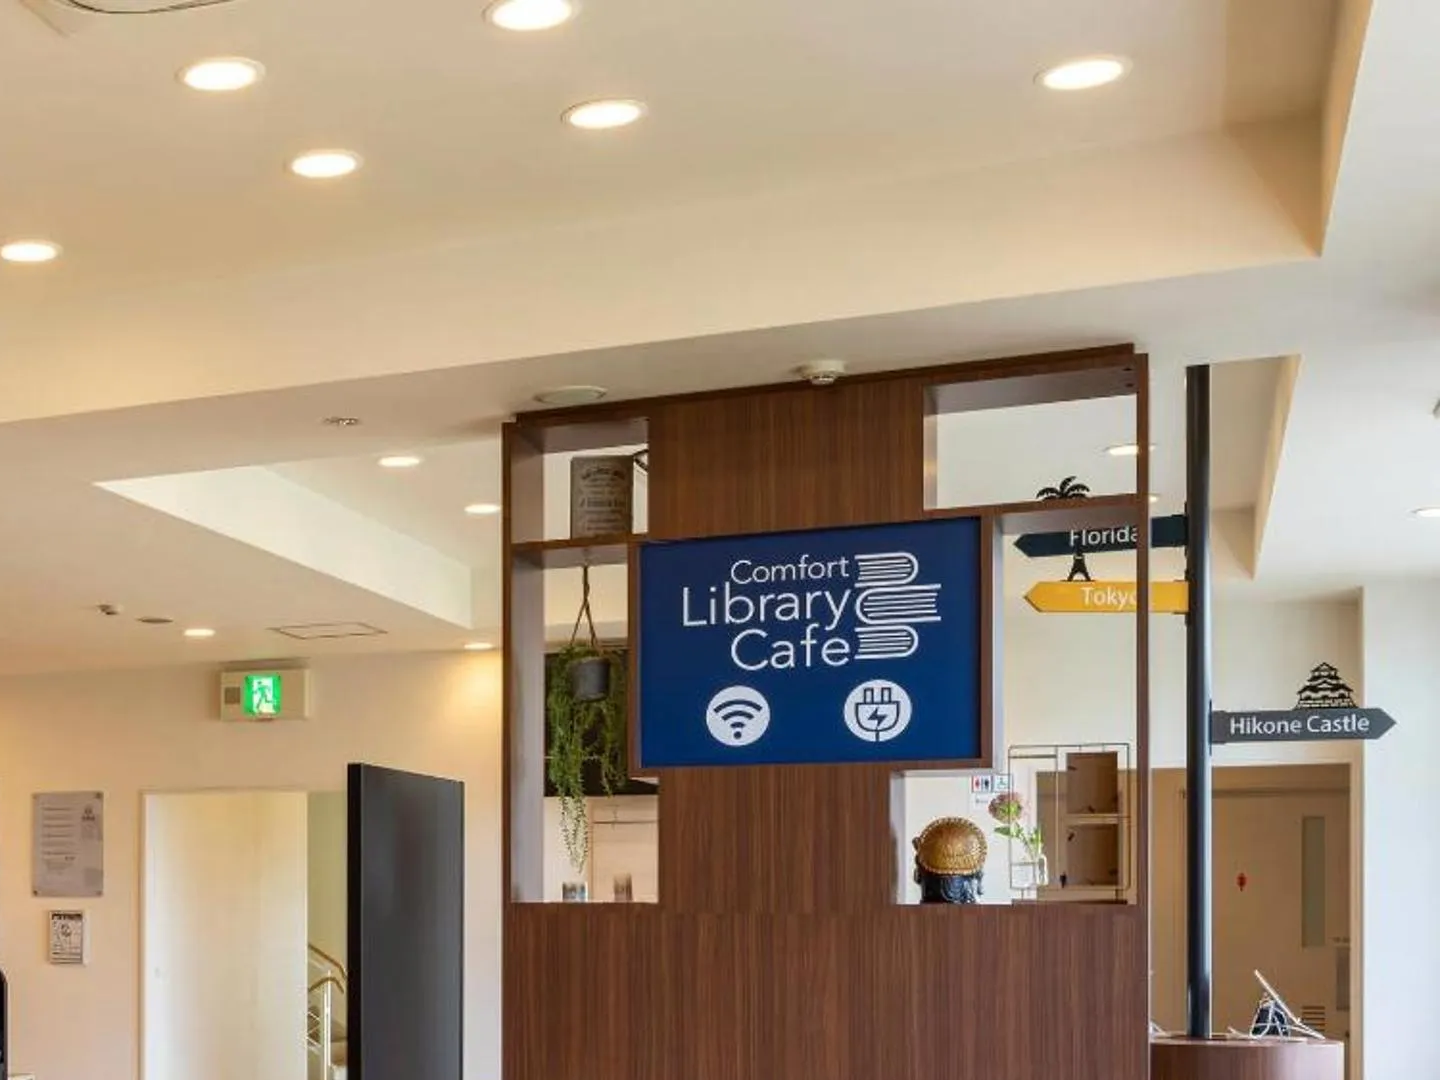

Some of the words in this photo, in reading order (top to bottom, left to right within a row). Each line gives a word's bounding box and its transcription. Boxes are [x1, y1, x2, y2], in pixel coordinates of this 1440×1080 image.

[730, 554, 850, 585] Comfort
[682, 581, 852, 631] Library
[730, 622, 851, 671] Cafe
[1229, 715, 1302, 735] Hikone
[1306, 713, 1370, 733] Castle
